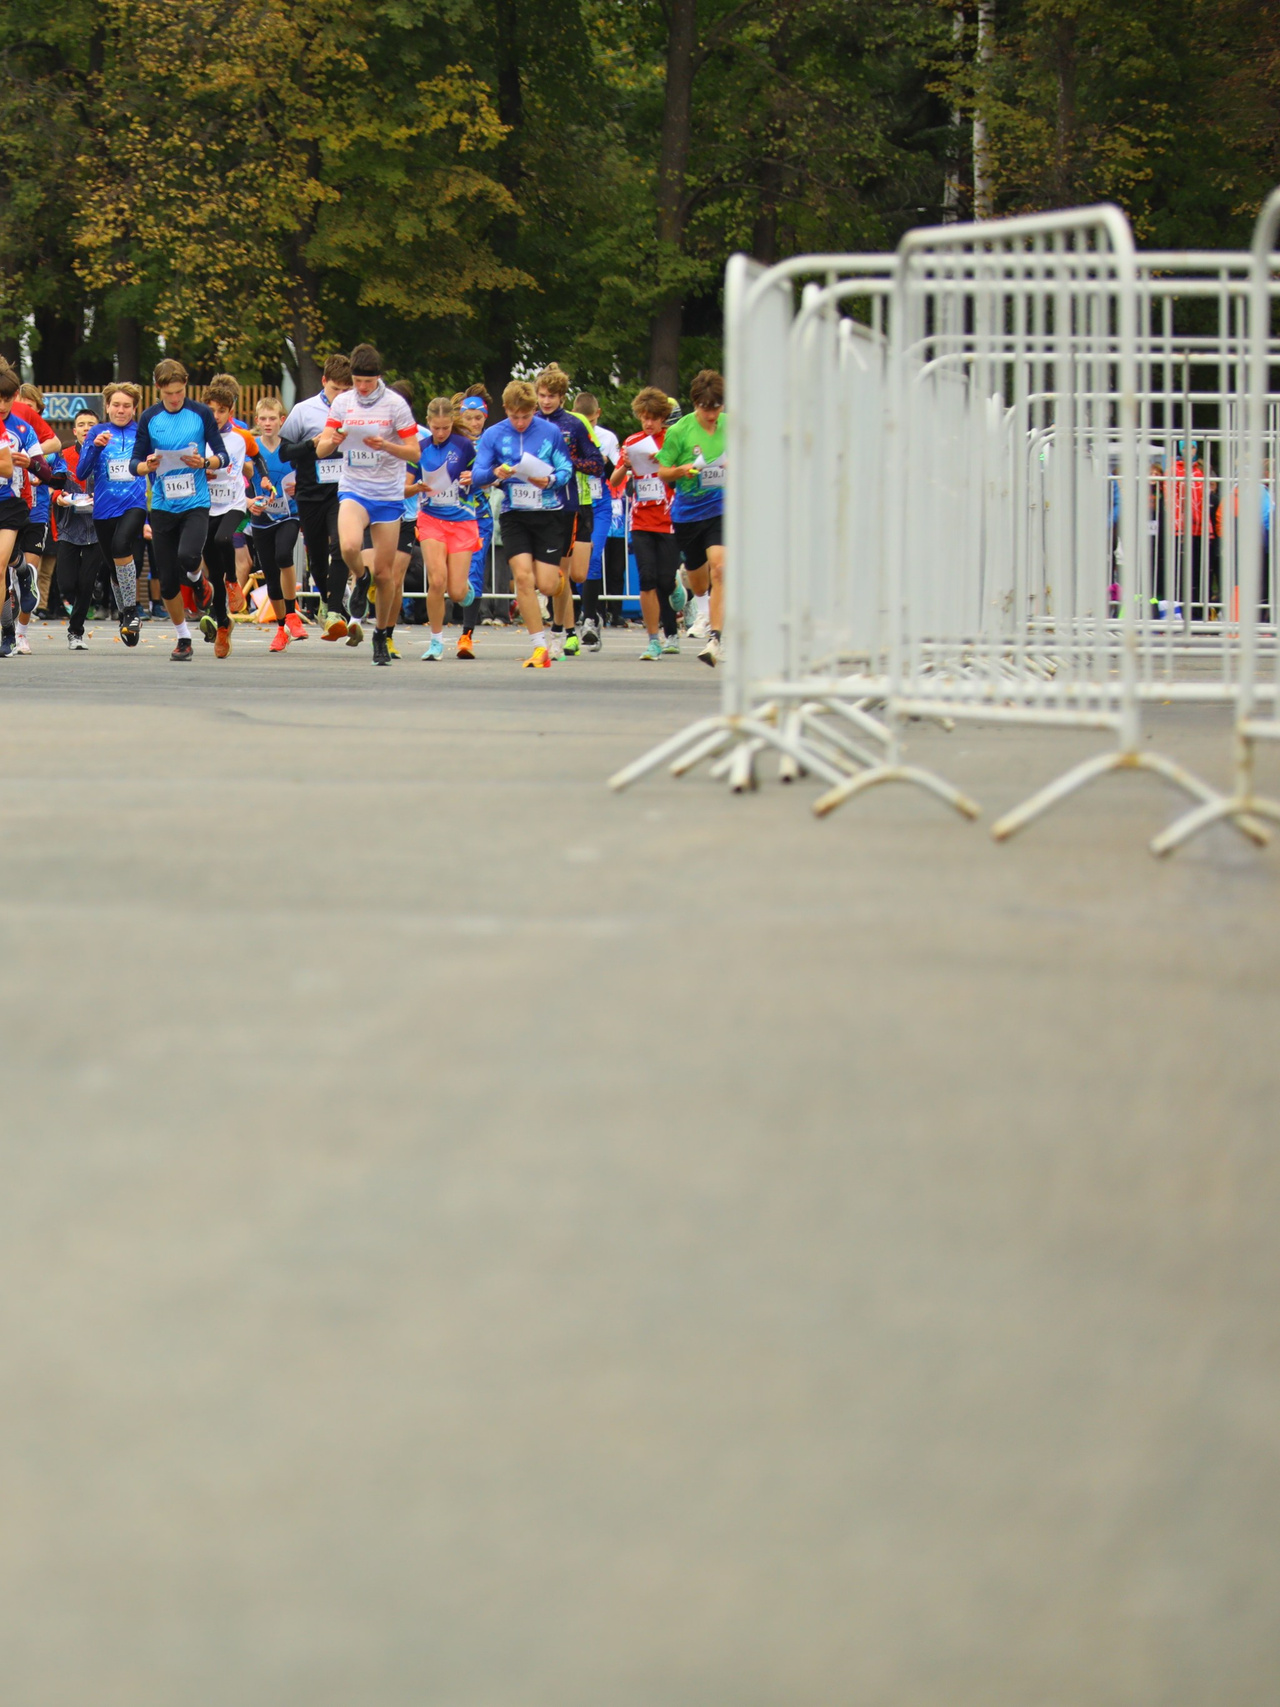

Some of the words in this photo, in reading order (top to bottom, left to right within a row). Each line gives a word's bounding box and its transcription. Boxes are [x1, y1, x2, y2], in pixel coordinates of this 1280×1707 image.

[351, 452, 374, 460] 318.1
[320, 465, 343, 474] 337.1
[166, 481, 190, 491] 316.1
[638, 484, 658, 493] 367.1
[209, 486, 231, 497] 317.1
[513, 488, 537, 499] 339.1
